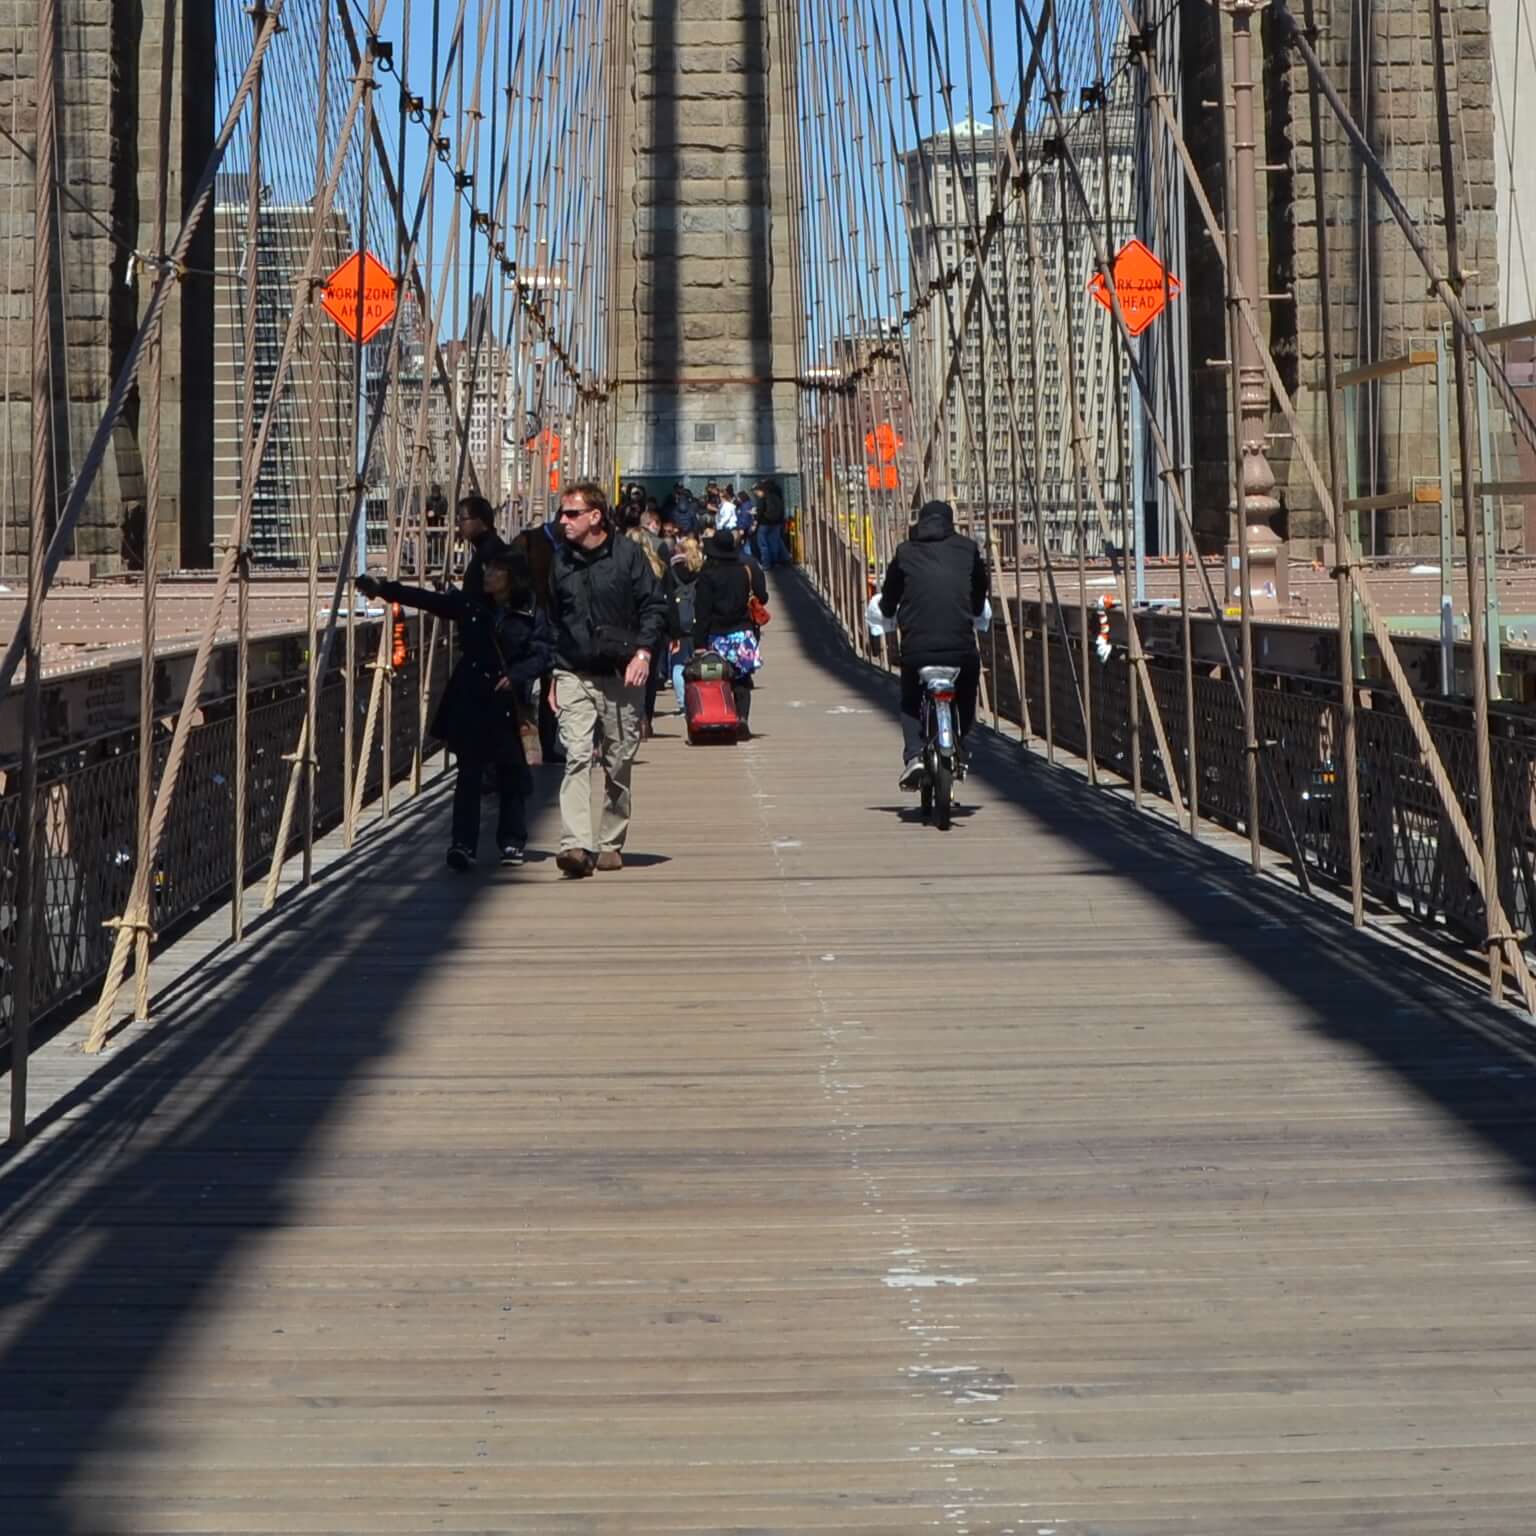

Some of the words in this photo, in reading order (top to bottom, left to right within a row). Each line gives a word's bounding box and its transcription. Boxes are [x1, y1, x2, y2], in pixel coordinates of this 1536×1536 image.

[1099, 278, 1132, 291] WRK
[1137, 279, 1162, 291] ZON
[365, 288, 396, 301] ZONE
[1120, 296, 1155, 309] HEAD
[341, 305, 382, 318] AHAD
